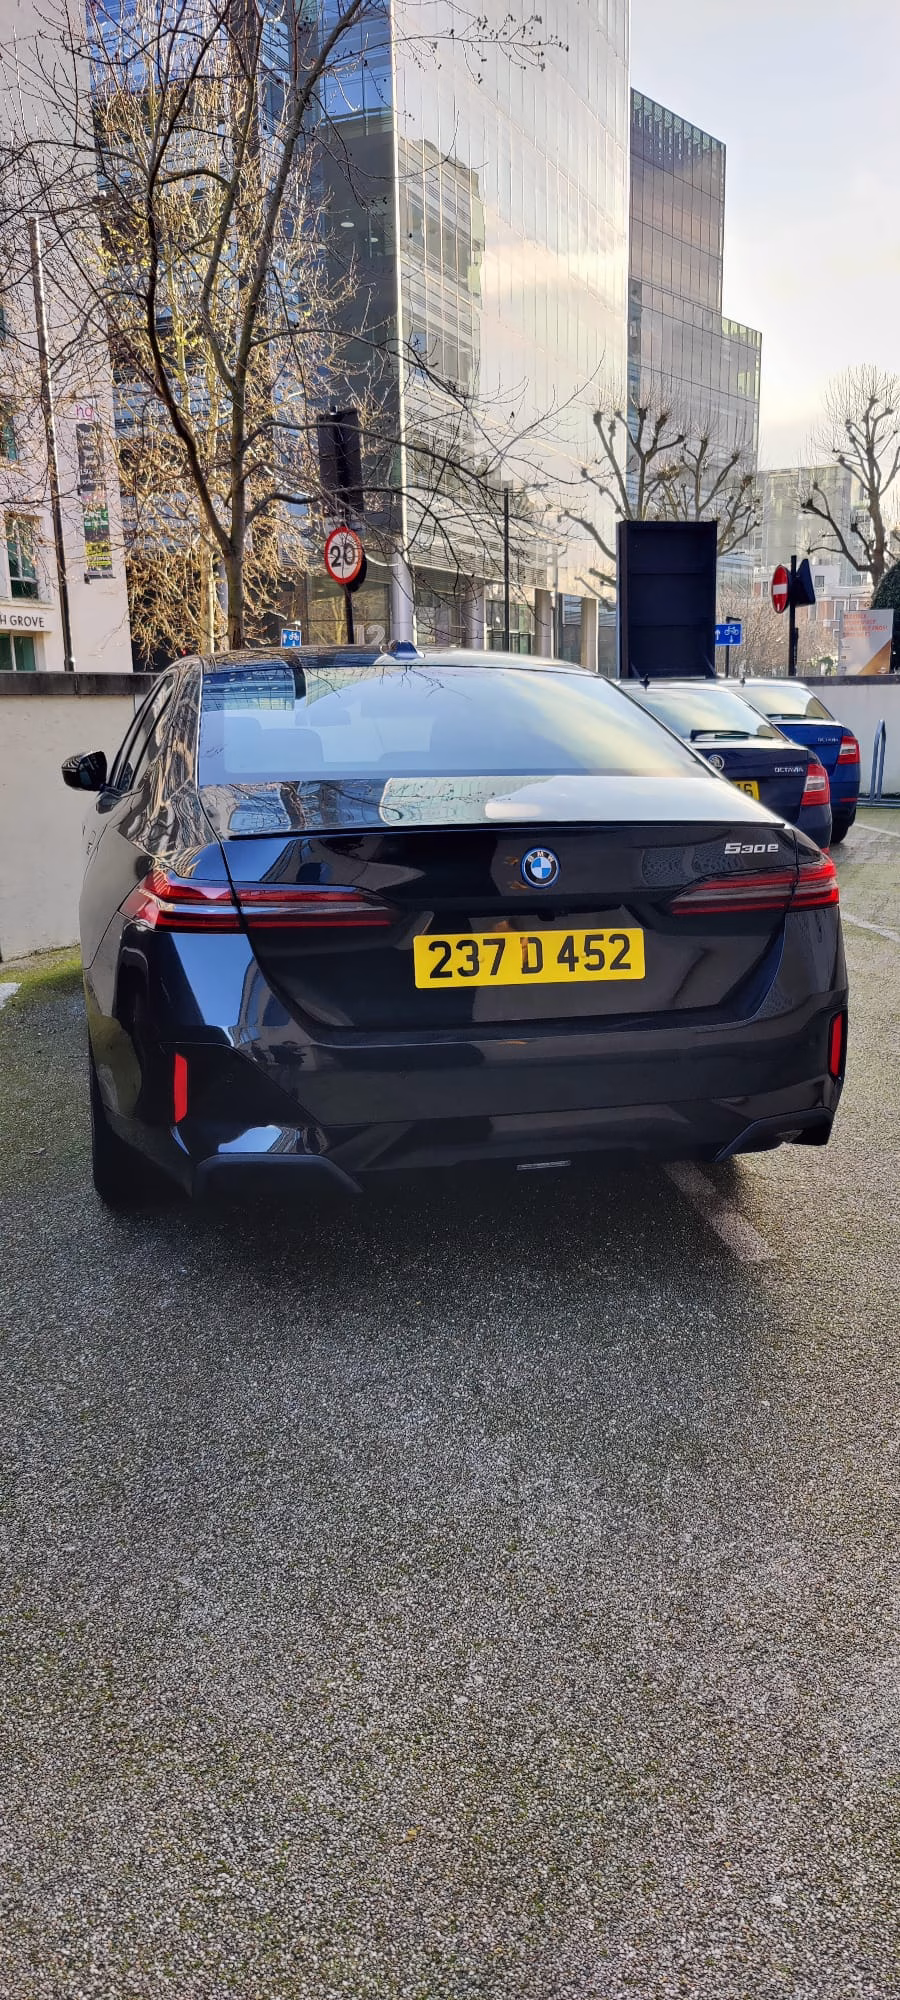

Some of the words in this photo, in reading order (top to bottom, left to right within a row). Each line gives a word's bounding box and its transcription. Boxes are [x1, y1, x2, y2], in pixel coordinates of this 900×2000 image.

[330, 544, 355, 567] 20
[9, 615, 46, 628] GROVE
[774, 766, 804, 774] OCTAVIA
[724, 842, 780, 855] 530e
[527, 851, 556, 863] BMW
[428, 938, 506, 979] 237
[519, 936, 544, 975] D
[556, 933, 632, 972] 452
